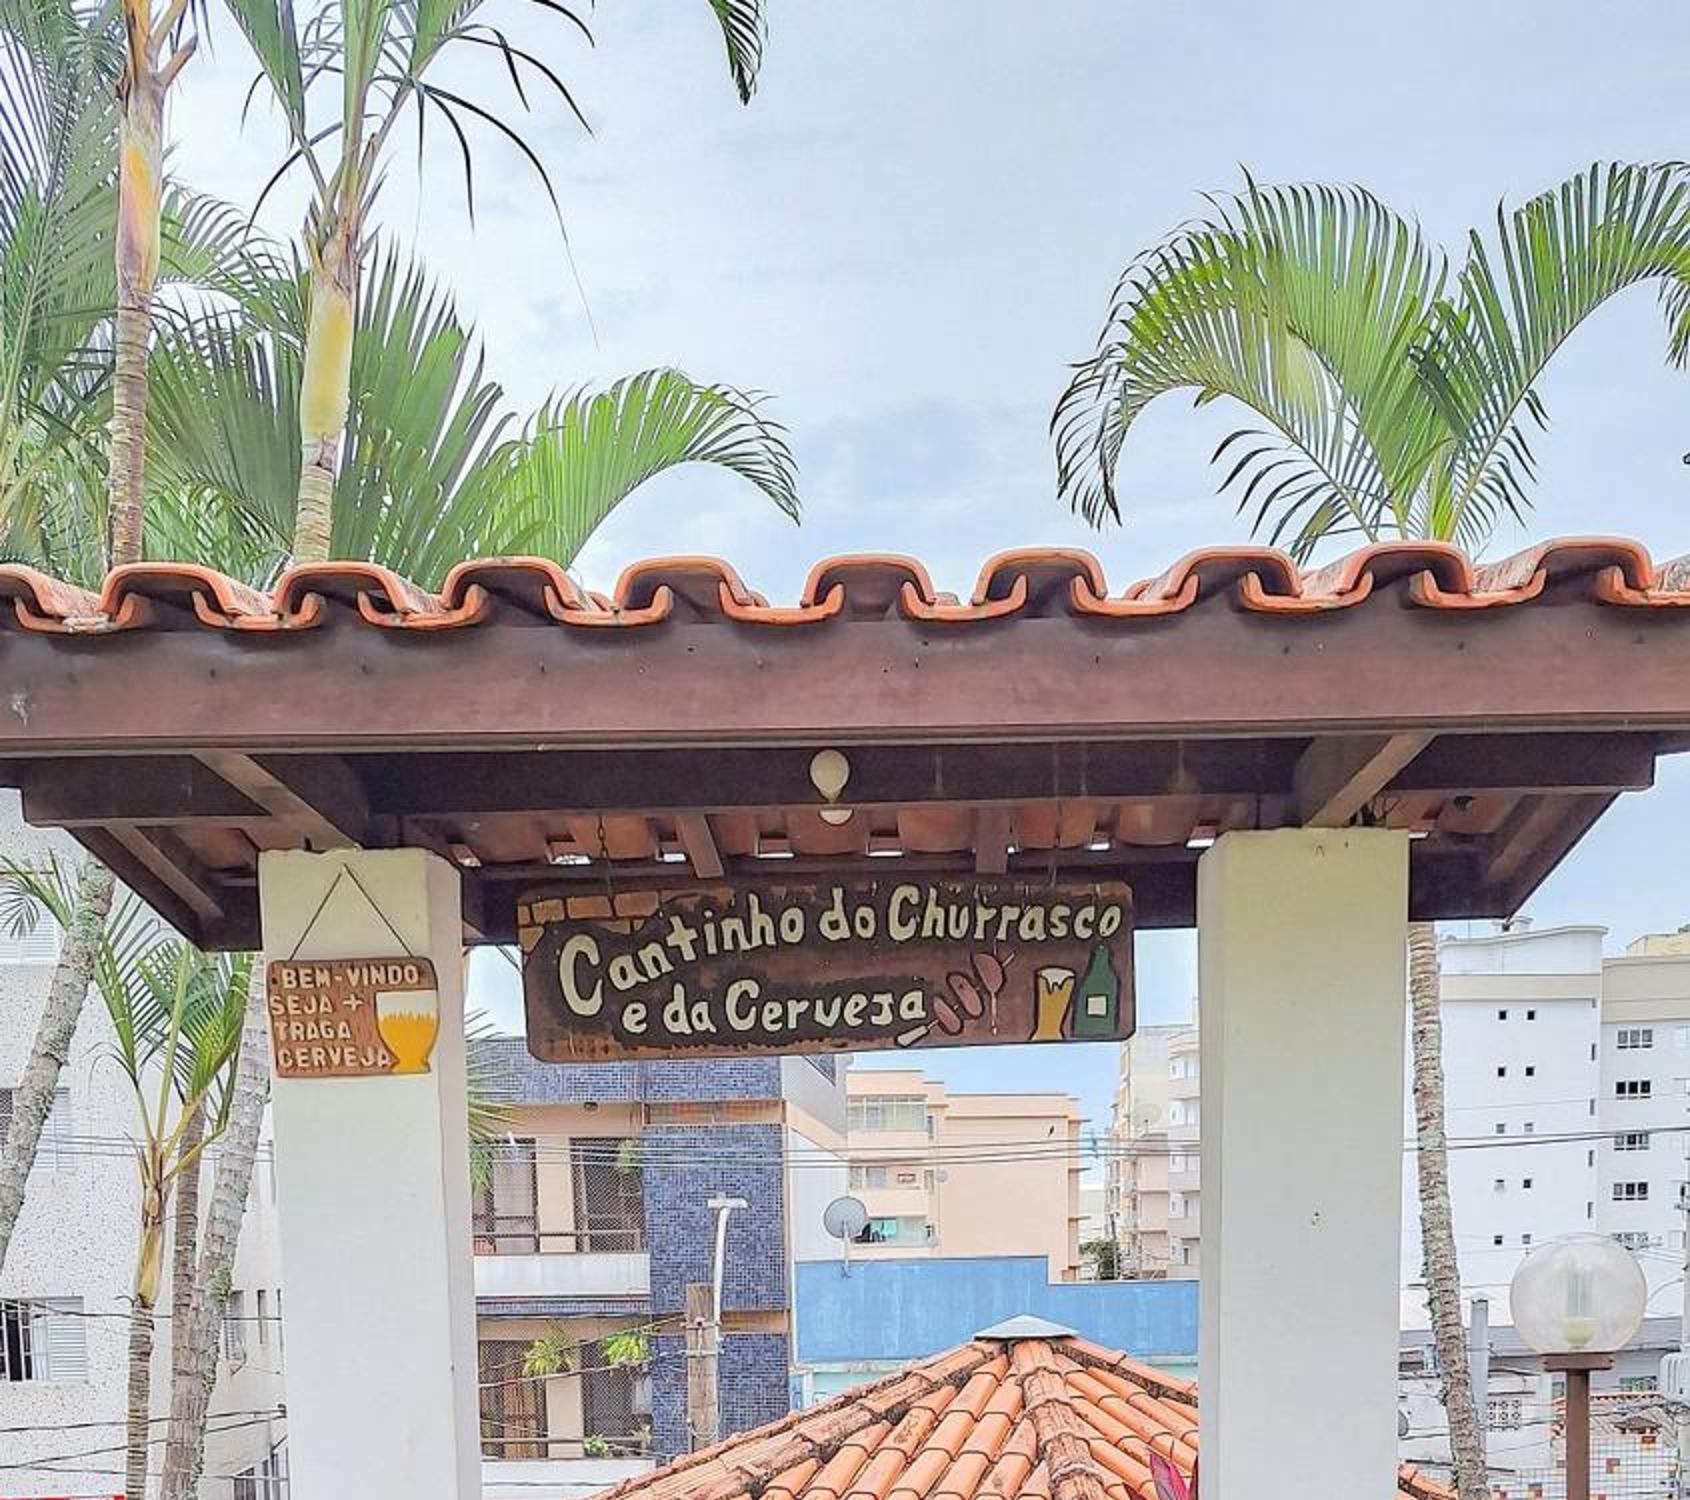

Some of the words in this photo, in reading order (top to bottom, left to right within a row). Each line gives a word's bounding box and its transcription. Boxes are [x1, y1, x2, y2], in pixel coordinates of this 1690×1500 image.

[559, 894, 804, 1016] Cantinho
[819, 886, 877, 941] do
[888, 884, 1123, 942] Churrasco
[282, 965, 419, 988] BEM-VINDO
[271, 995, 333, 1016] SEJA
[621, 1001, 648, 1035] e
[662, 983, 717, 1035] da
[726, 980, 926, 1032] Cerveja
[274, 1020, 351, 1042] TRAGA
[279, 1046, 393, 1068] CERVEJA
